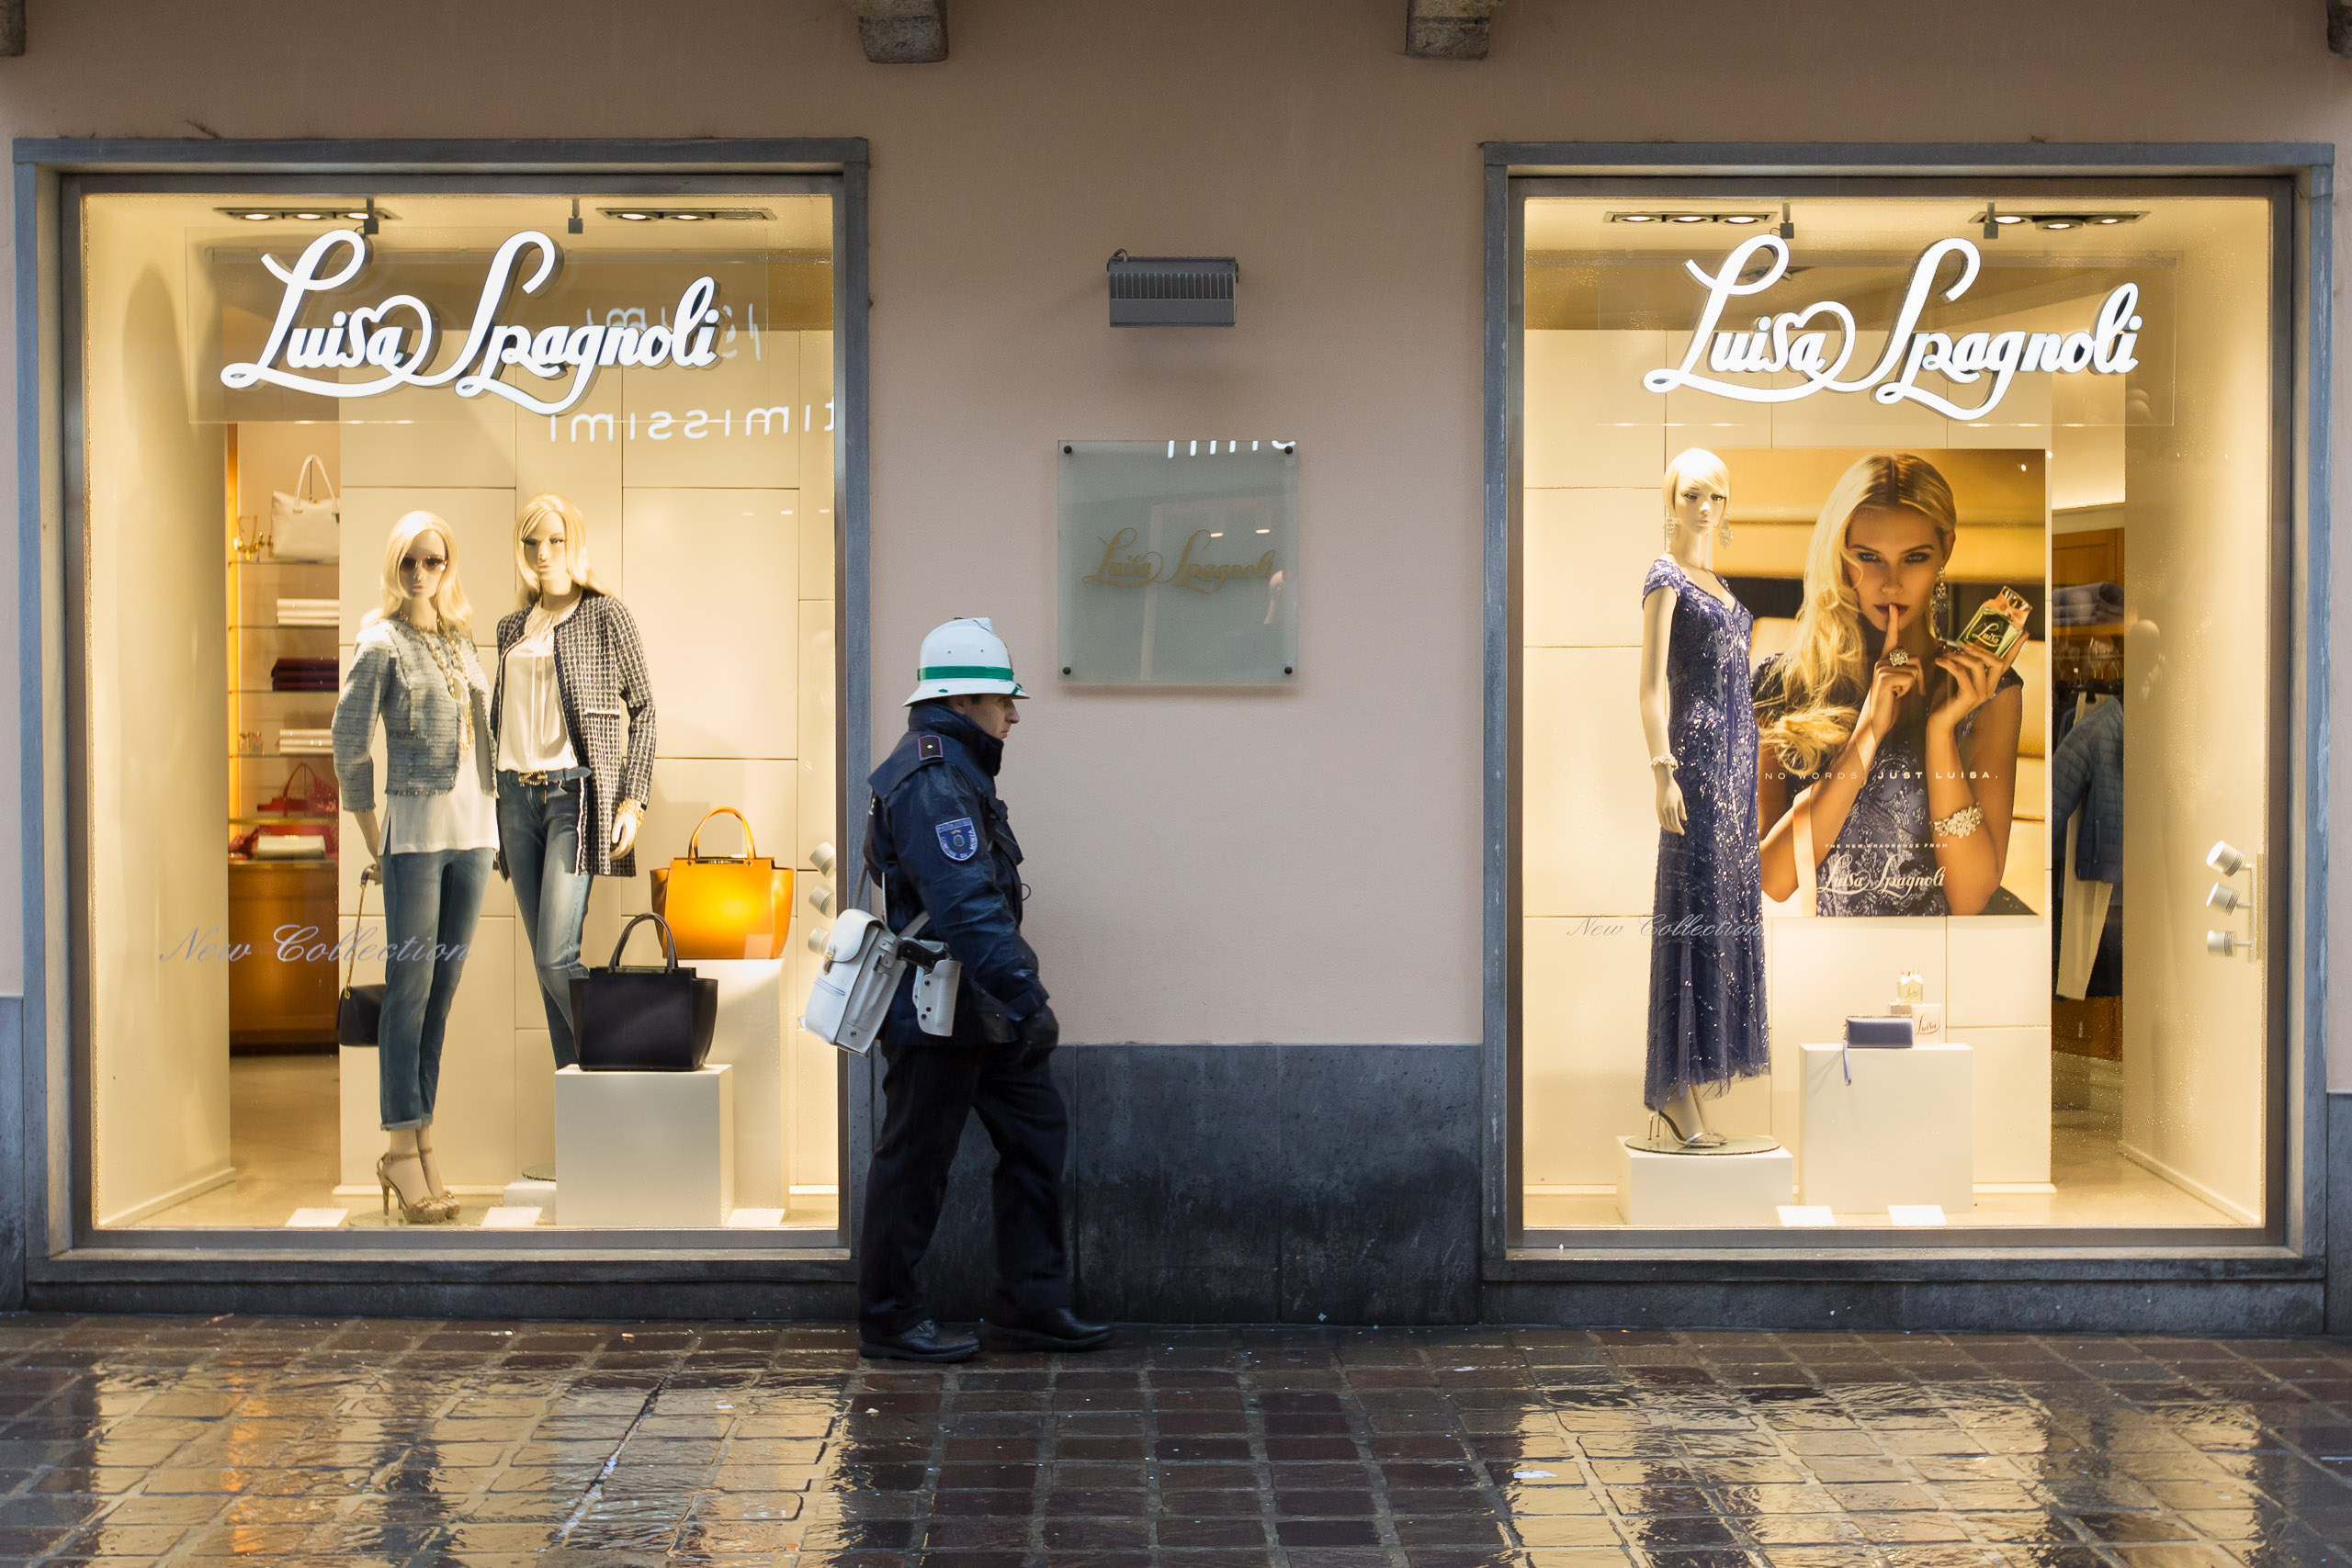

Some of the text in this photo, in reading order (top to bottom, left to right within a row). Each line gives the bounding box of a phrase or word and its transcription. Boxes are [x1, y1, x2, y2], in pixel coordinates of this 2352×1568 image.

[221, 229, 722, 415] Luisa Spagnoli
[1643, 234, 2143, 422] Luisa Spagnoli
[1082, 527, 1275, 595] Luisa Spagnoli
[1972, 622, 2003, 647] Luisa
[1765, 772, 1786, 780] NO
[1878, 772, 1923, 780] JUST
[1936, 772, 1998, 780] LUISA.
[1816, 853, 1947, 898] Luisa Spagnoli
[159, 924, 472, 963] New Collection
[1566, 913, 1763, 937] New Collection
[1917, 1013, 1940, 1035] Luisa
